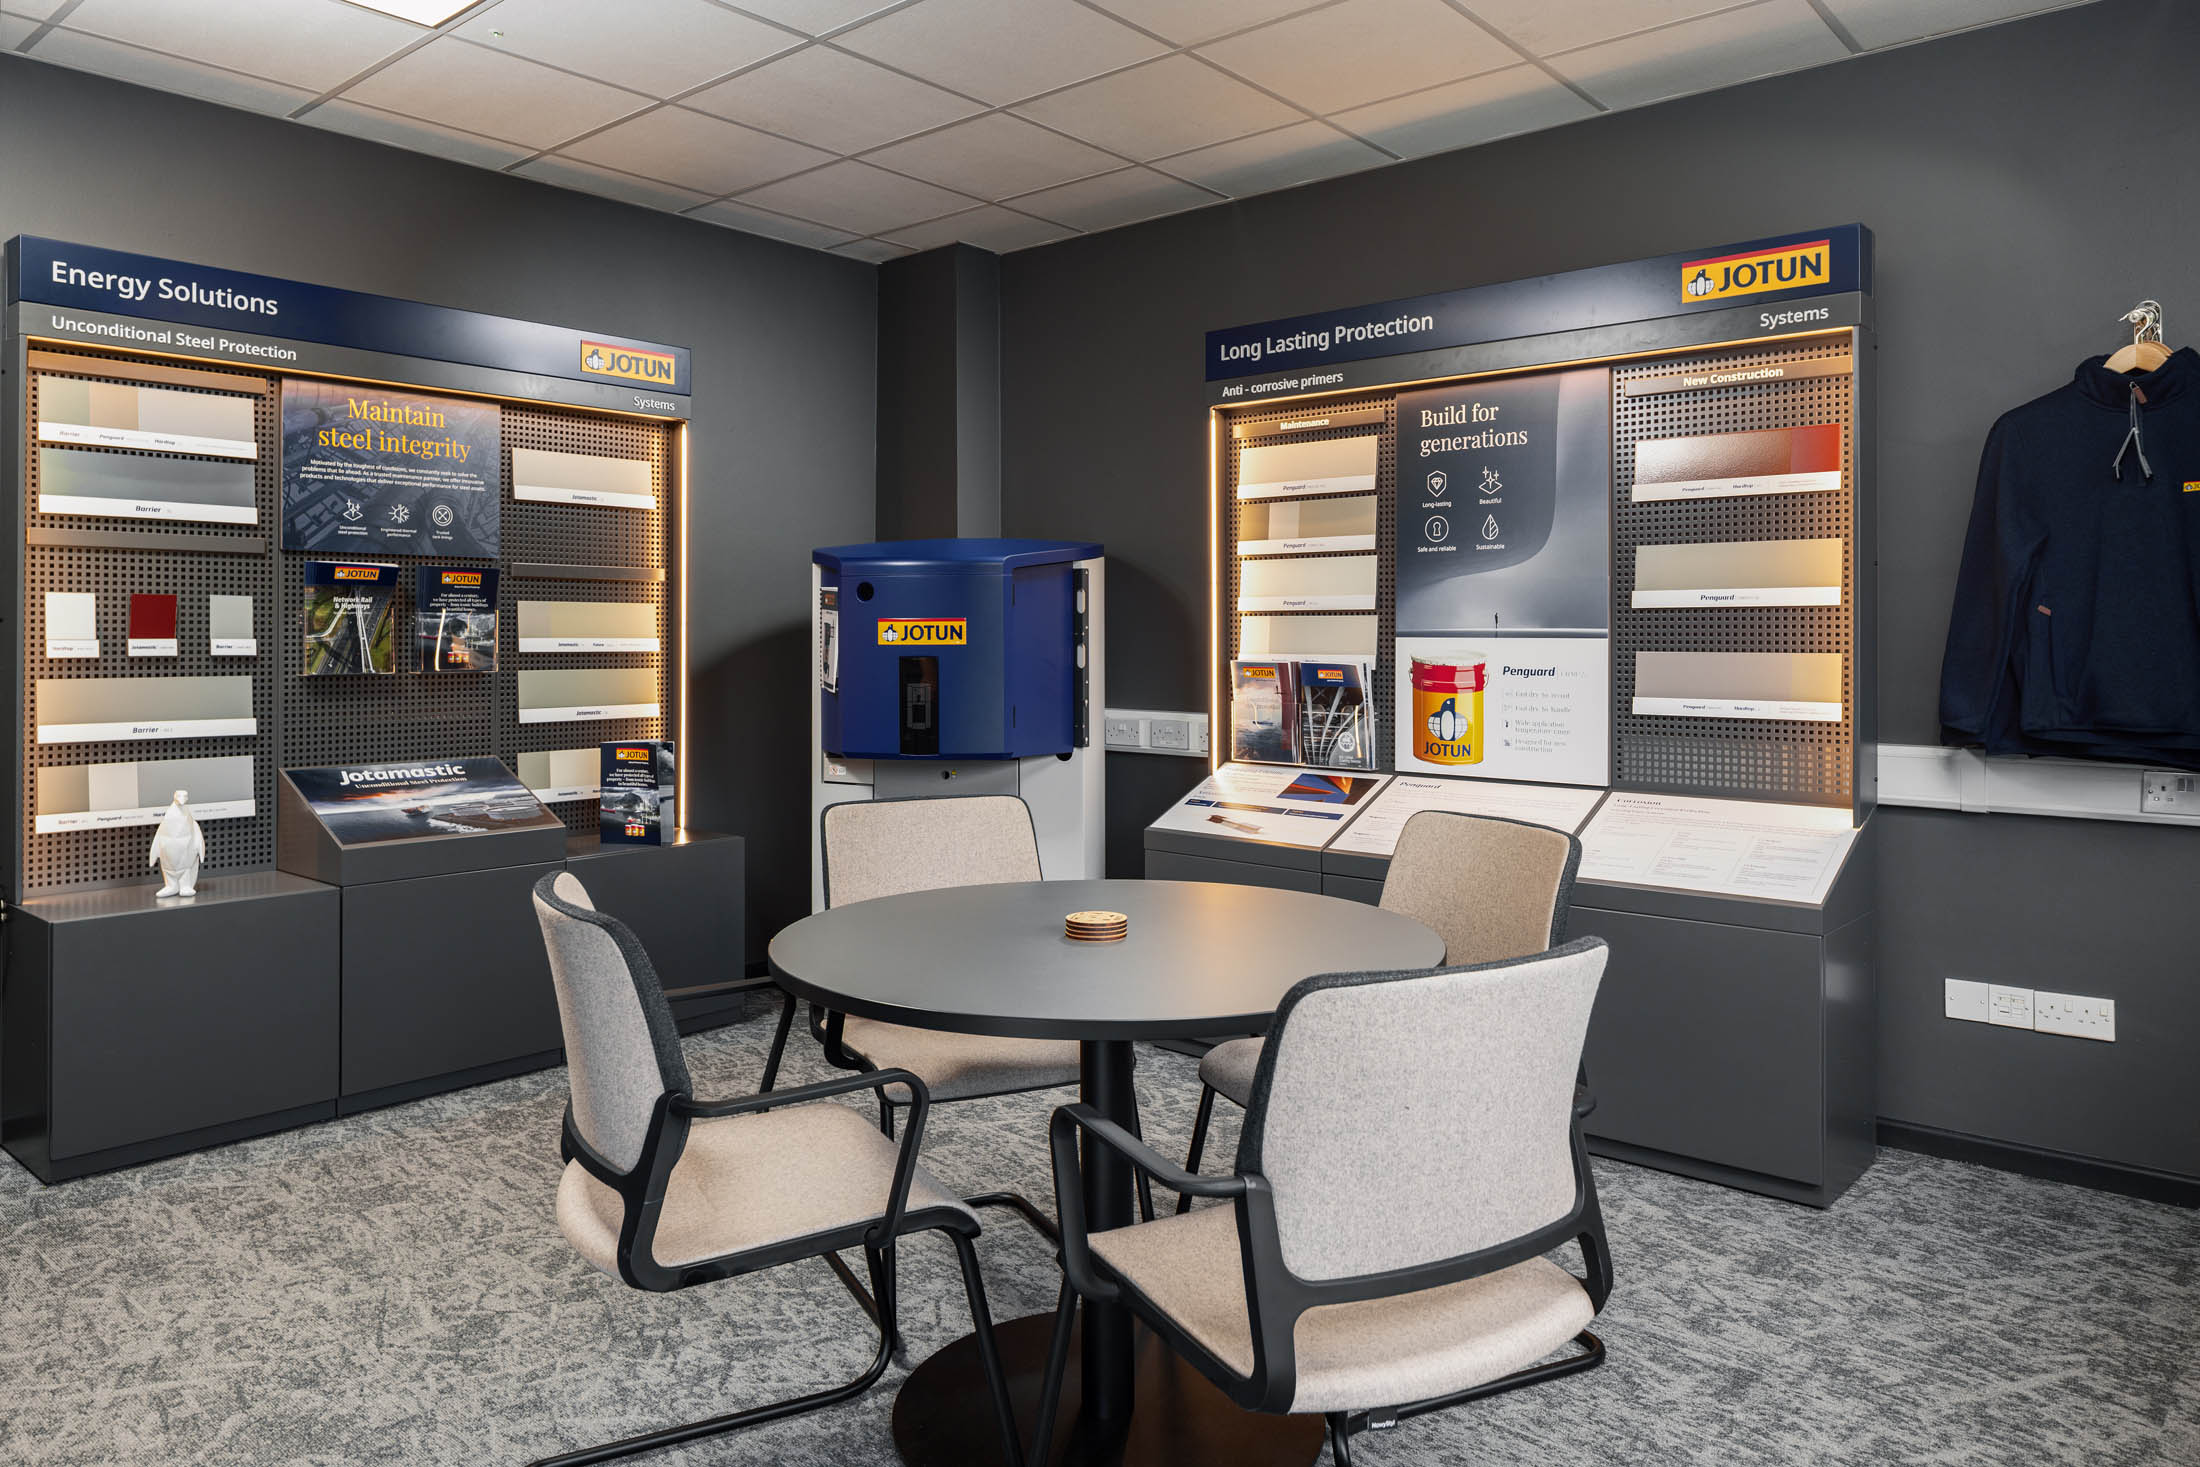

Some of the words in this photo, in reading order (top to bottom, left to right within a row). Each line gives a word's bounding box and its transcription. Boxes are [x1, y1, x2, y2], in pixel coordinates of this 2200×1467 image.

[1718, 252, 1821, 292] JOTUN
[52, 261, 151, 300] Energy
[159, 278, 278, 316] Solutions
[1760, 307, 1829, 330] Systems
[52, 315, 171, 345] Unconditional
[176, 329, 215, 350] Steel
[220, 338, 297, 361] Protection
[1220, 340, 1261, 361] Long
[1266, 332, 1330, 354] Lasting
[1335, 315, 1433, 344] Protection
[606, 353, 671, 379] JOTUN
[1222, 380, 1243, 397] Anti
[1251, 374, 1298, 394] corrosive
[1301, 371, 1344, 389] primers
[1683, 376, 1707, 387] New
[1710, 367, 1784, 384] Construction
[634, 396, 675, 411] Systems
[347, 398, 445, 428] Maintain
[1420, 404, 1467, 428] Build
[1472, 403, 1499, 422] for
[1280, 418, 1330, 431] Maintenance
[319, 428, 373, 450] steel
[380, 431, 471, 463] integrity
[1420, 428, 1528, 457] generations
[135, 505, 161, 513] Barrier
[1422, 500, 1452, 509] Long-lasting
[1479, 497, 1502, 505] Beautiful
[1476, 543, 1505, 551] Sustainable
[346, 570, 376, 578] JOTUN
[1700, 594, 1735, 602] Penguard
[900, 624, 963, 641] JOTUN
[1251, 668, 1274, 677] JOTUN
[1503, 666, 1555, 678] Penguard
[1423, 741, 1471, 758] JOTUN
[340, 764, 466, 786] Jotamastic
[355, 781, 410, 789] Unconditional
